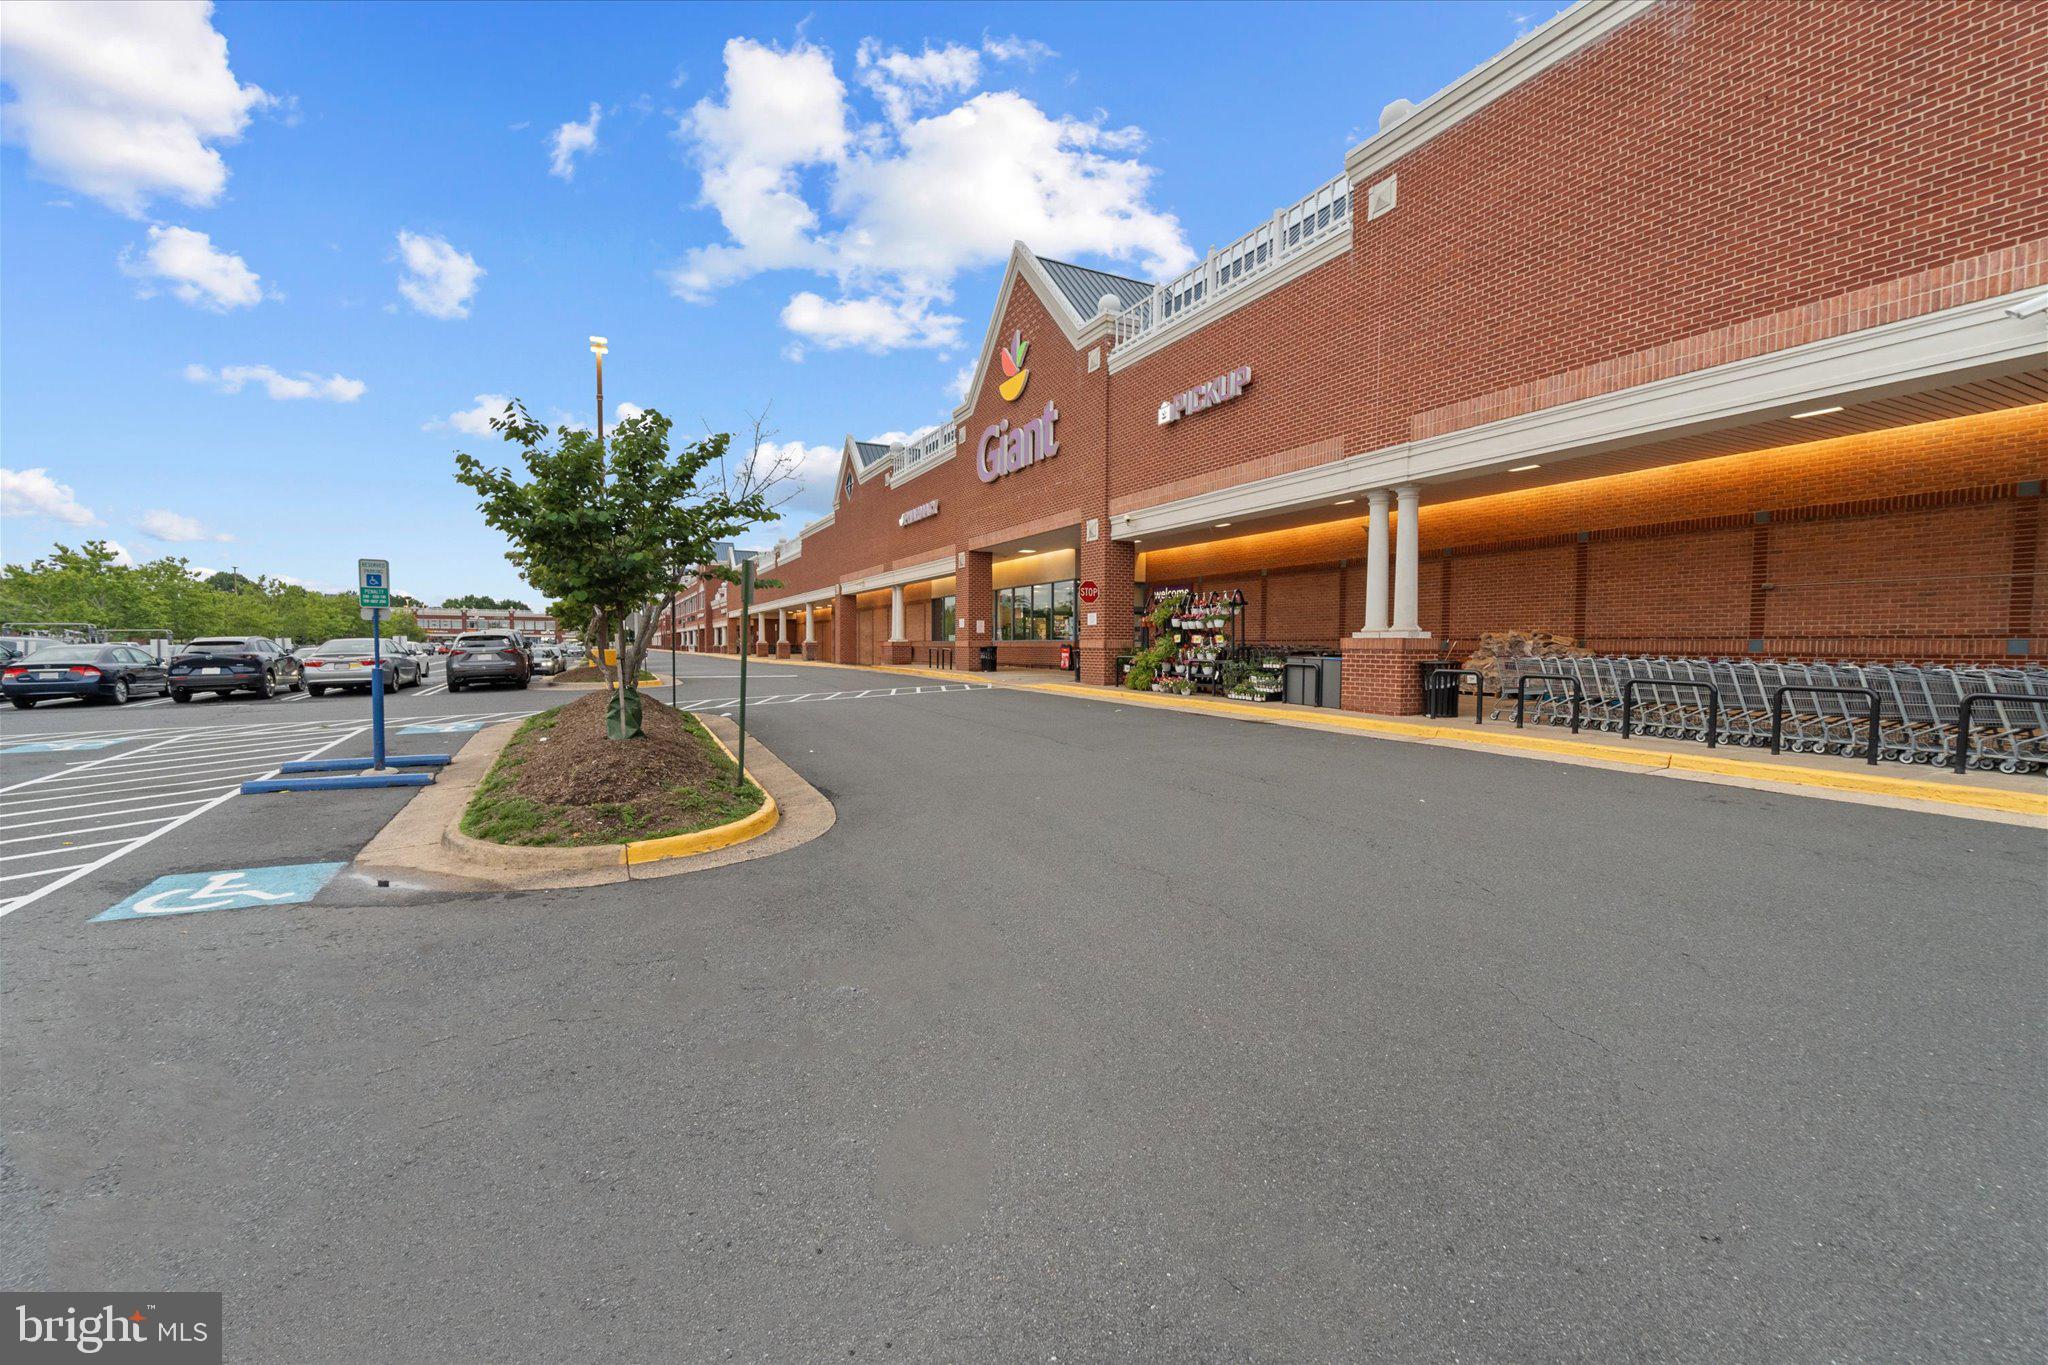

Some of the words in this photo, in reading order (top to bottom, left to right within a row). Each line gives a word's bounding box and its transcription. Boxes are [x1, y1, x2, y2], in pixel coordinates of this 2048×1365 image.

[1173, 365, 1251, 420] PICKUP
[976, 400, 1060, 484] Giant
[1080, 587, 1098, 597] STOP
